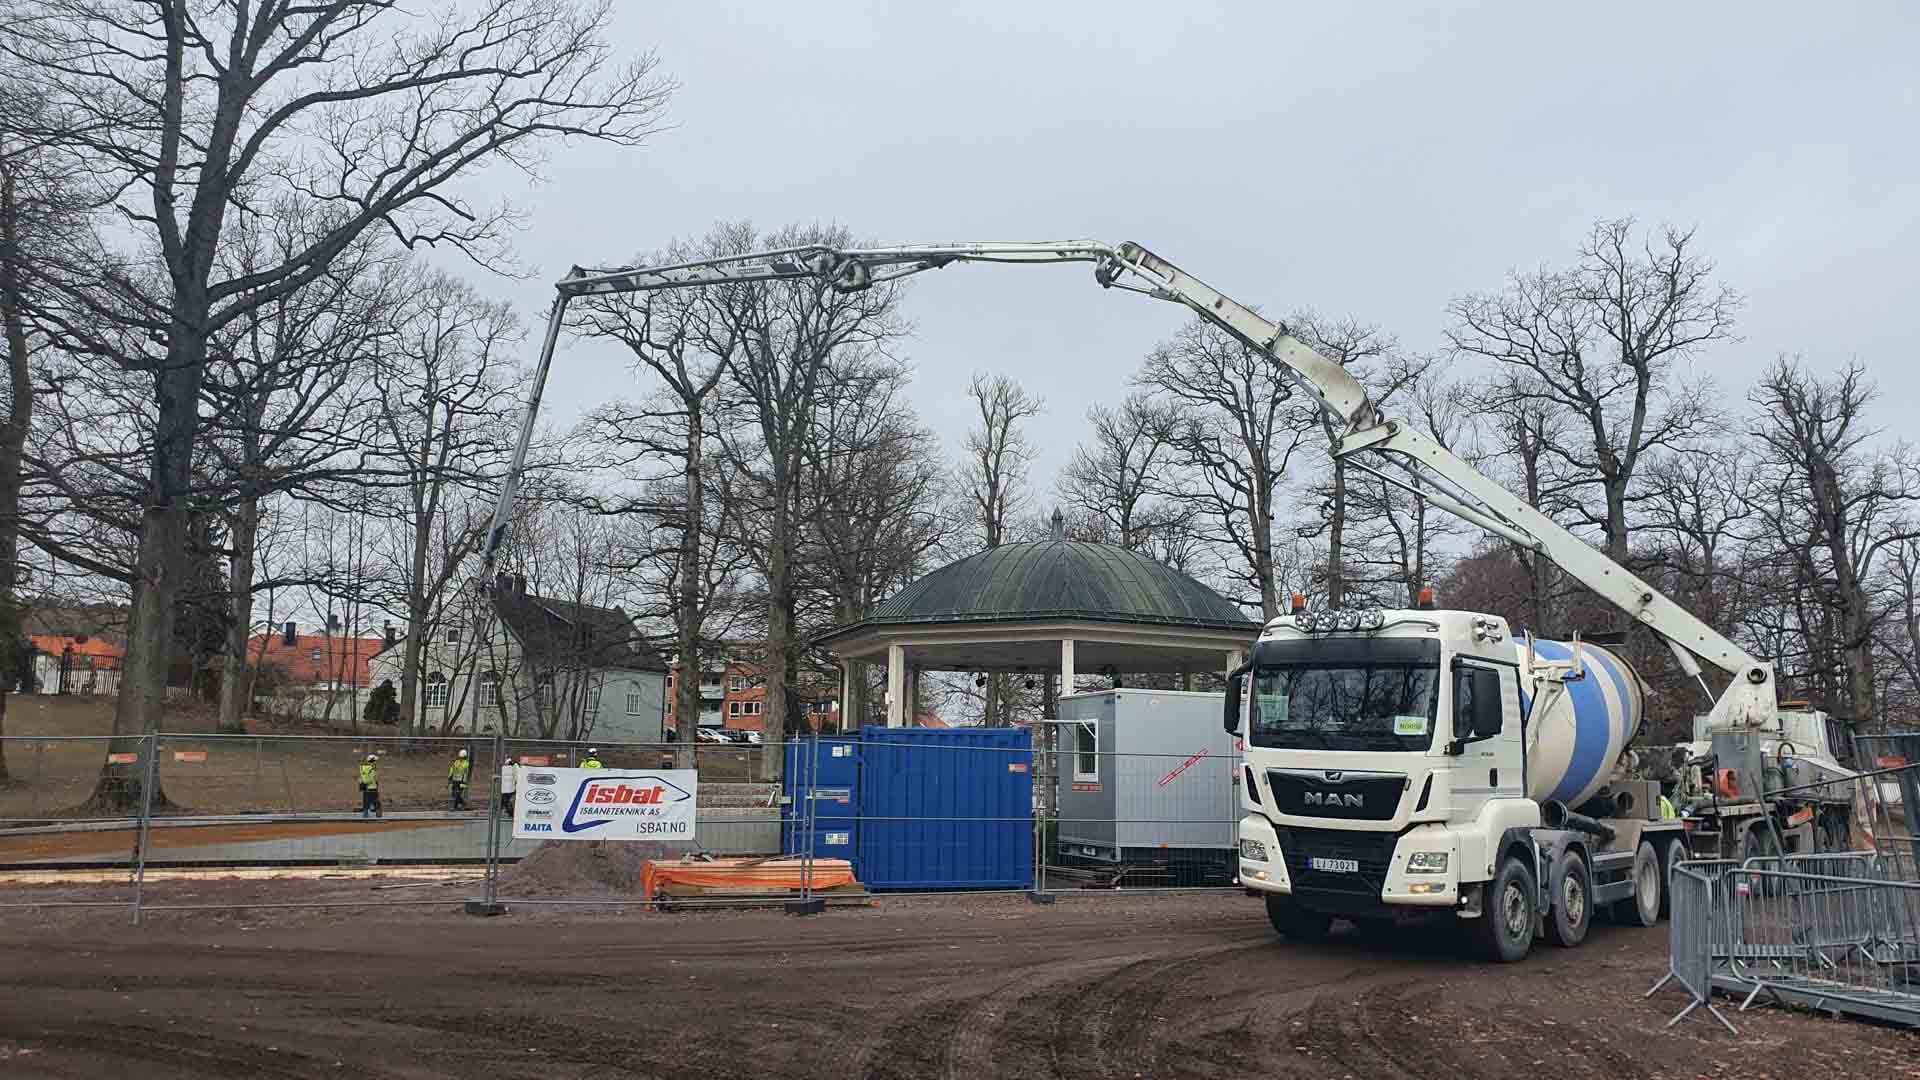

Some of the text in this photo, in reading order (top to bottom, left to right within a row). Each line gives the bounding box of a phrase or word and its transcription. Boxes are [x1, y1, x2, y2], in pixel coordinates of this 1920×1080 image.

[585, 784, 665, 804] isbat
[1304, 792, 1363, 808] MAN
[580, 807, 660, 816] ISBANETEKNIKK AS
[524, 823, 553, 832] RAITA
[636, 822, 686, 833] ISBAT.NO
